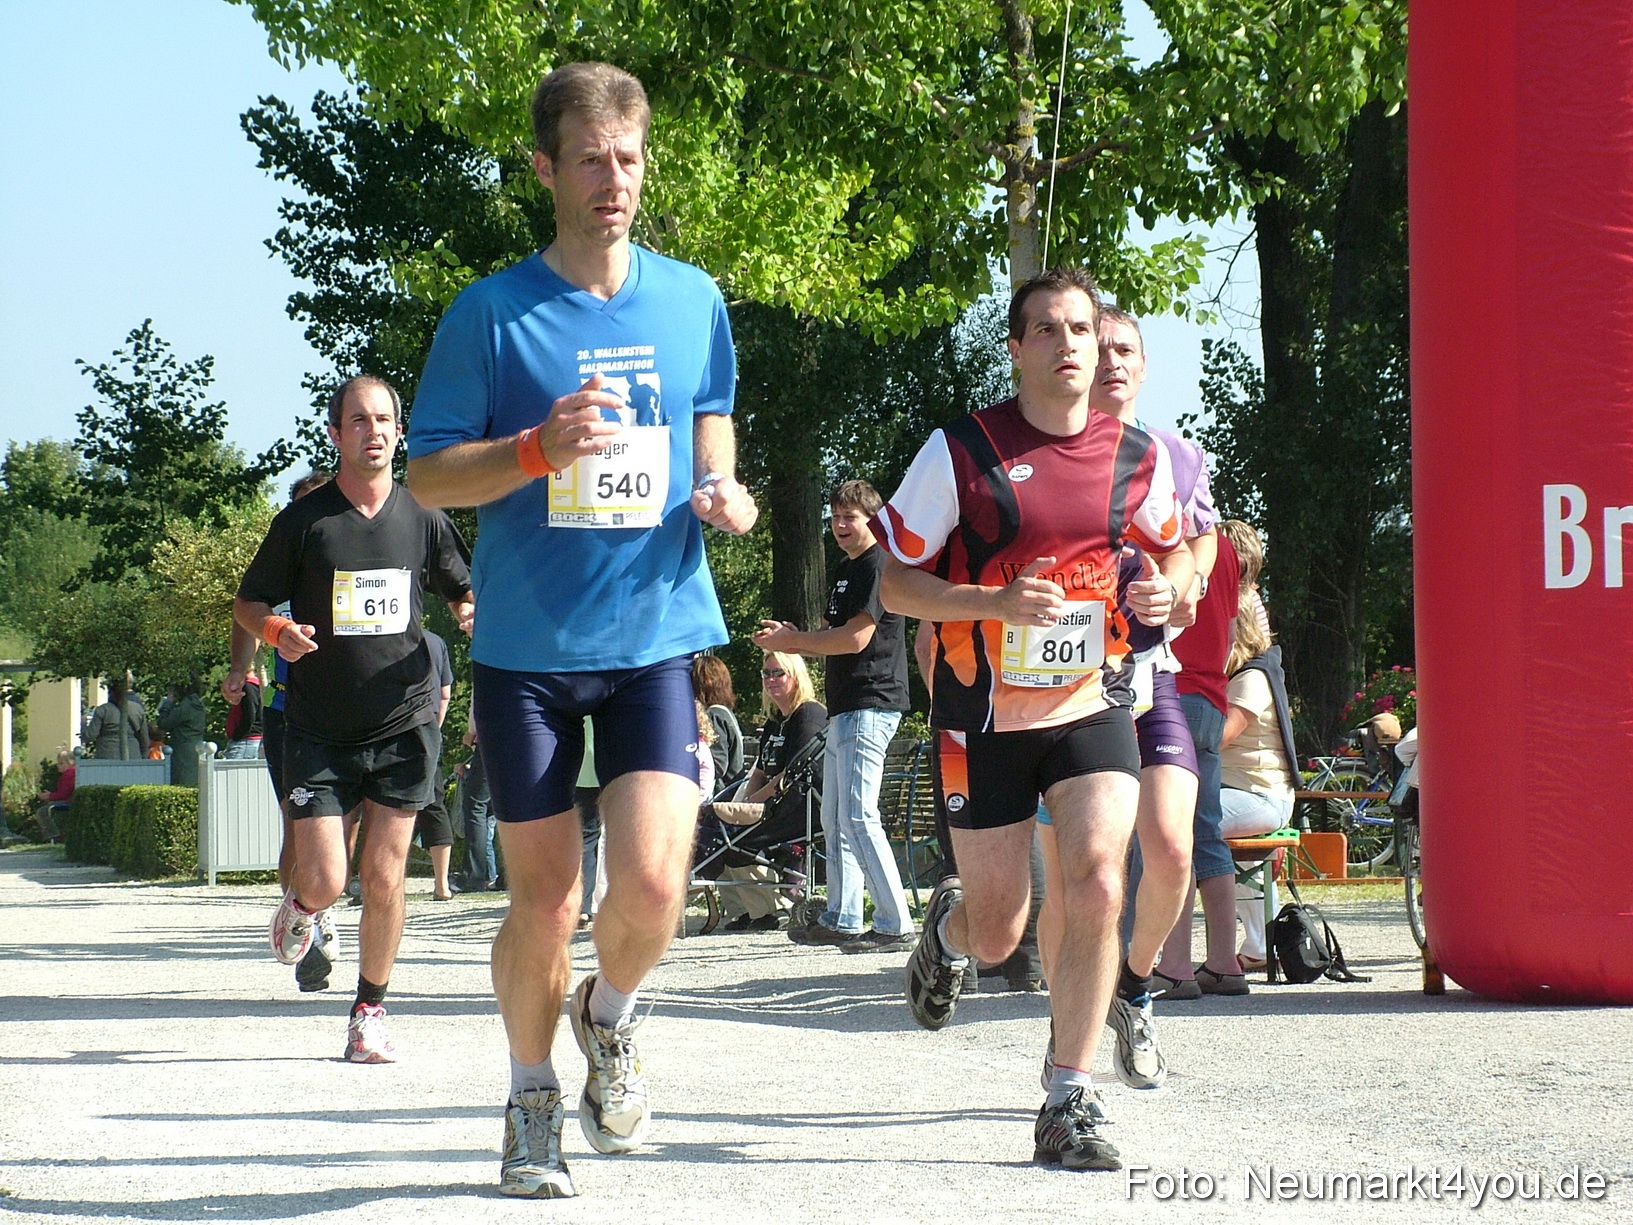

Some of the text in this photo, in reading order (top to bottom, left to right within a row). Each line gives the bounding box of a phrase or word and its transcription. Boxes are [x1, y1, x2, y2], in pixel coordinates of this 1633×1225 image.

[594, 345, 655, 359] WALLENSTEIN
[578, 358, 655, 374] HALBMARATHON
[597, 472, 651, 499] 540
[550, 512, 597, 523] BOCK
[355, 577, 387, 589] Simon
[336, 595, 342, 605] C
[364, 598, 399, 616] 616
[1006, 631, 1014, 643] B
[1042, 639, 1087, 663] 801
[1002, 671, 1040, 682] BOCK
